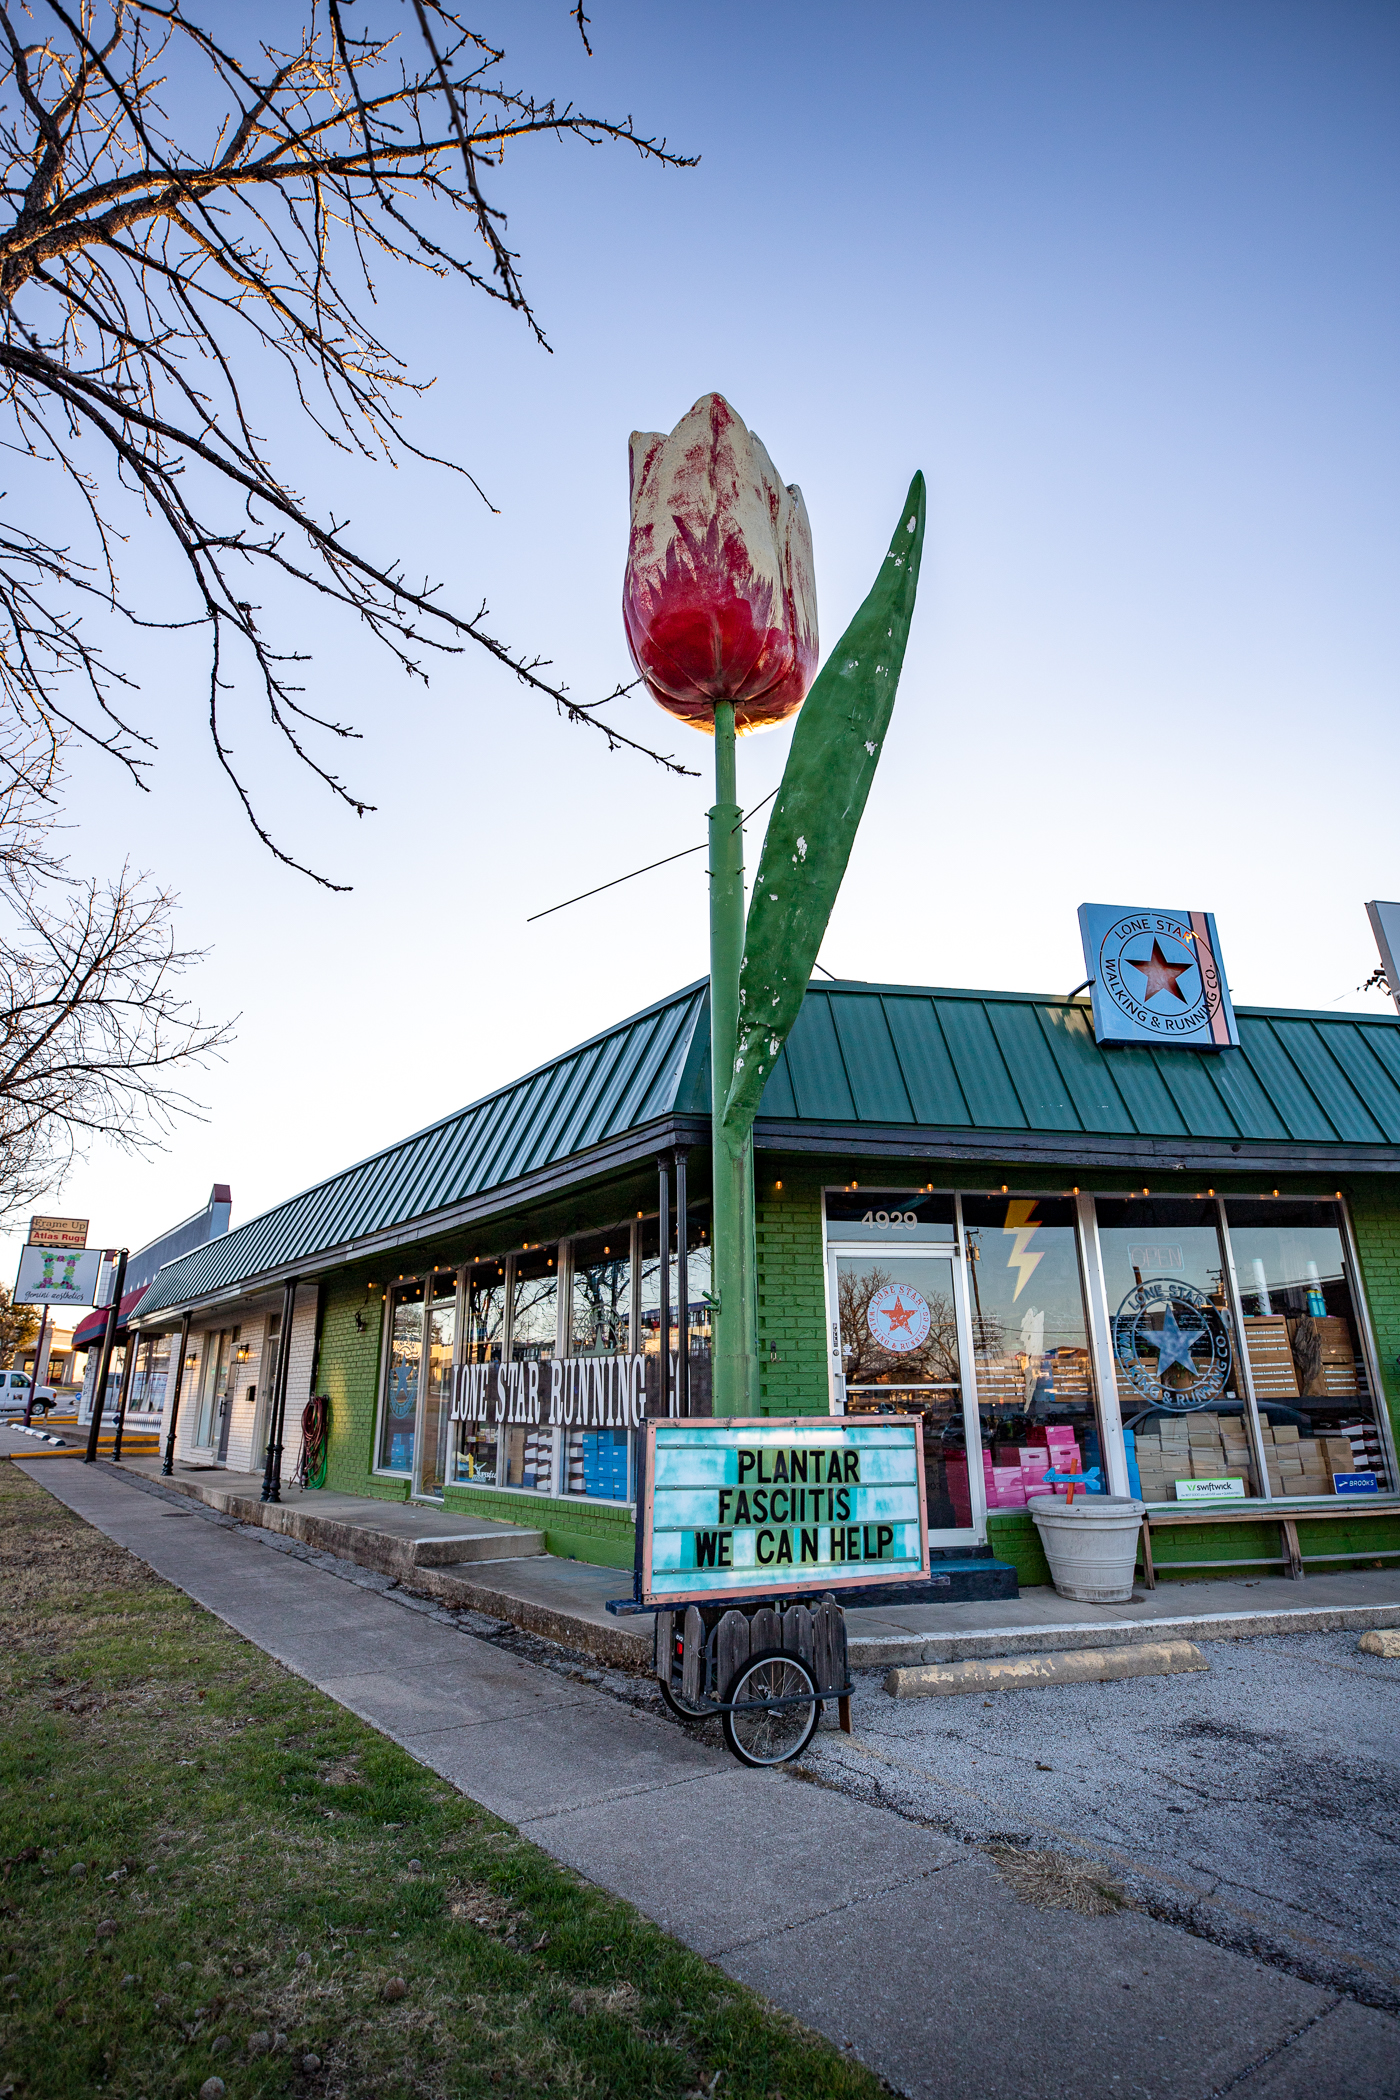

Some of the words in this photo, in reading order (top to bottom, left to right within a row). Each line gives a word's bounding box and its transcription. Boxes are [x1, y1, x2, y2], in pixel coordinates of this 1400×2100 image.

[1114, 919, 1150, 940] LONE
[1156, 920, 1193, 943] STAR
[1105, 959, 1146, 1022] WALKING
[1151, 1016, 1160, 1028] &
[1165, 991, 1217, 1030] RUNNING
[34, 1219, 68, 1228] Frame
[72, 1222, 86, 1230] Up
[861, 1211, 918, 1230] 4929
[62, 1234, 86, 1242] Rugs
[1130, 1247, 1182, 1268] OPEN
[872, 1286, 895, 1305] LONE
[899, 1286, 923, 1305] STAR
[1128, 1284, 1164, 1311] LONE
[1168, 1284, 1206, 1309] STAR
[869, 1311, 889, 1346] WALKING
[900, 1325, 928, 1350] RUNNING
[1119, 1332, 1160, 1398] WALKING
[1163, 1390, 1173, 1405] &
[1177, 1360, 1227, 1406] RUNNING
[83, 1386, 88, 1396] UP
[450, 1363, 489, 1422] LONE
[495, 1361, 541, 1425] STAR
[549, 1354, 646, 1428] RUNNING
[738, 1450, 860, 1484] PLANTAR
[1196, 1482, 1232, 1491] swiftwick
[719, 1488, 850, 1524] FASCIITIS
[696, 1532, 732, 1567] WE
[756, 1528, 818, 1564] CAN
[830, 1526, 894, 1561] HELP
